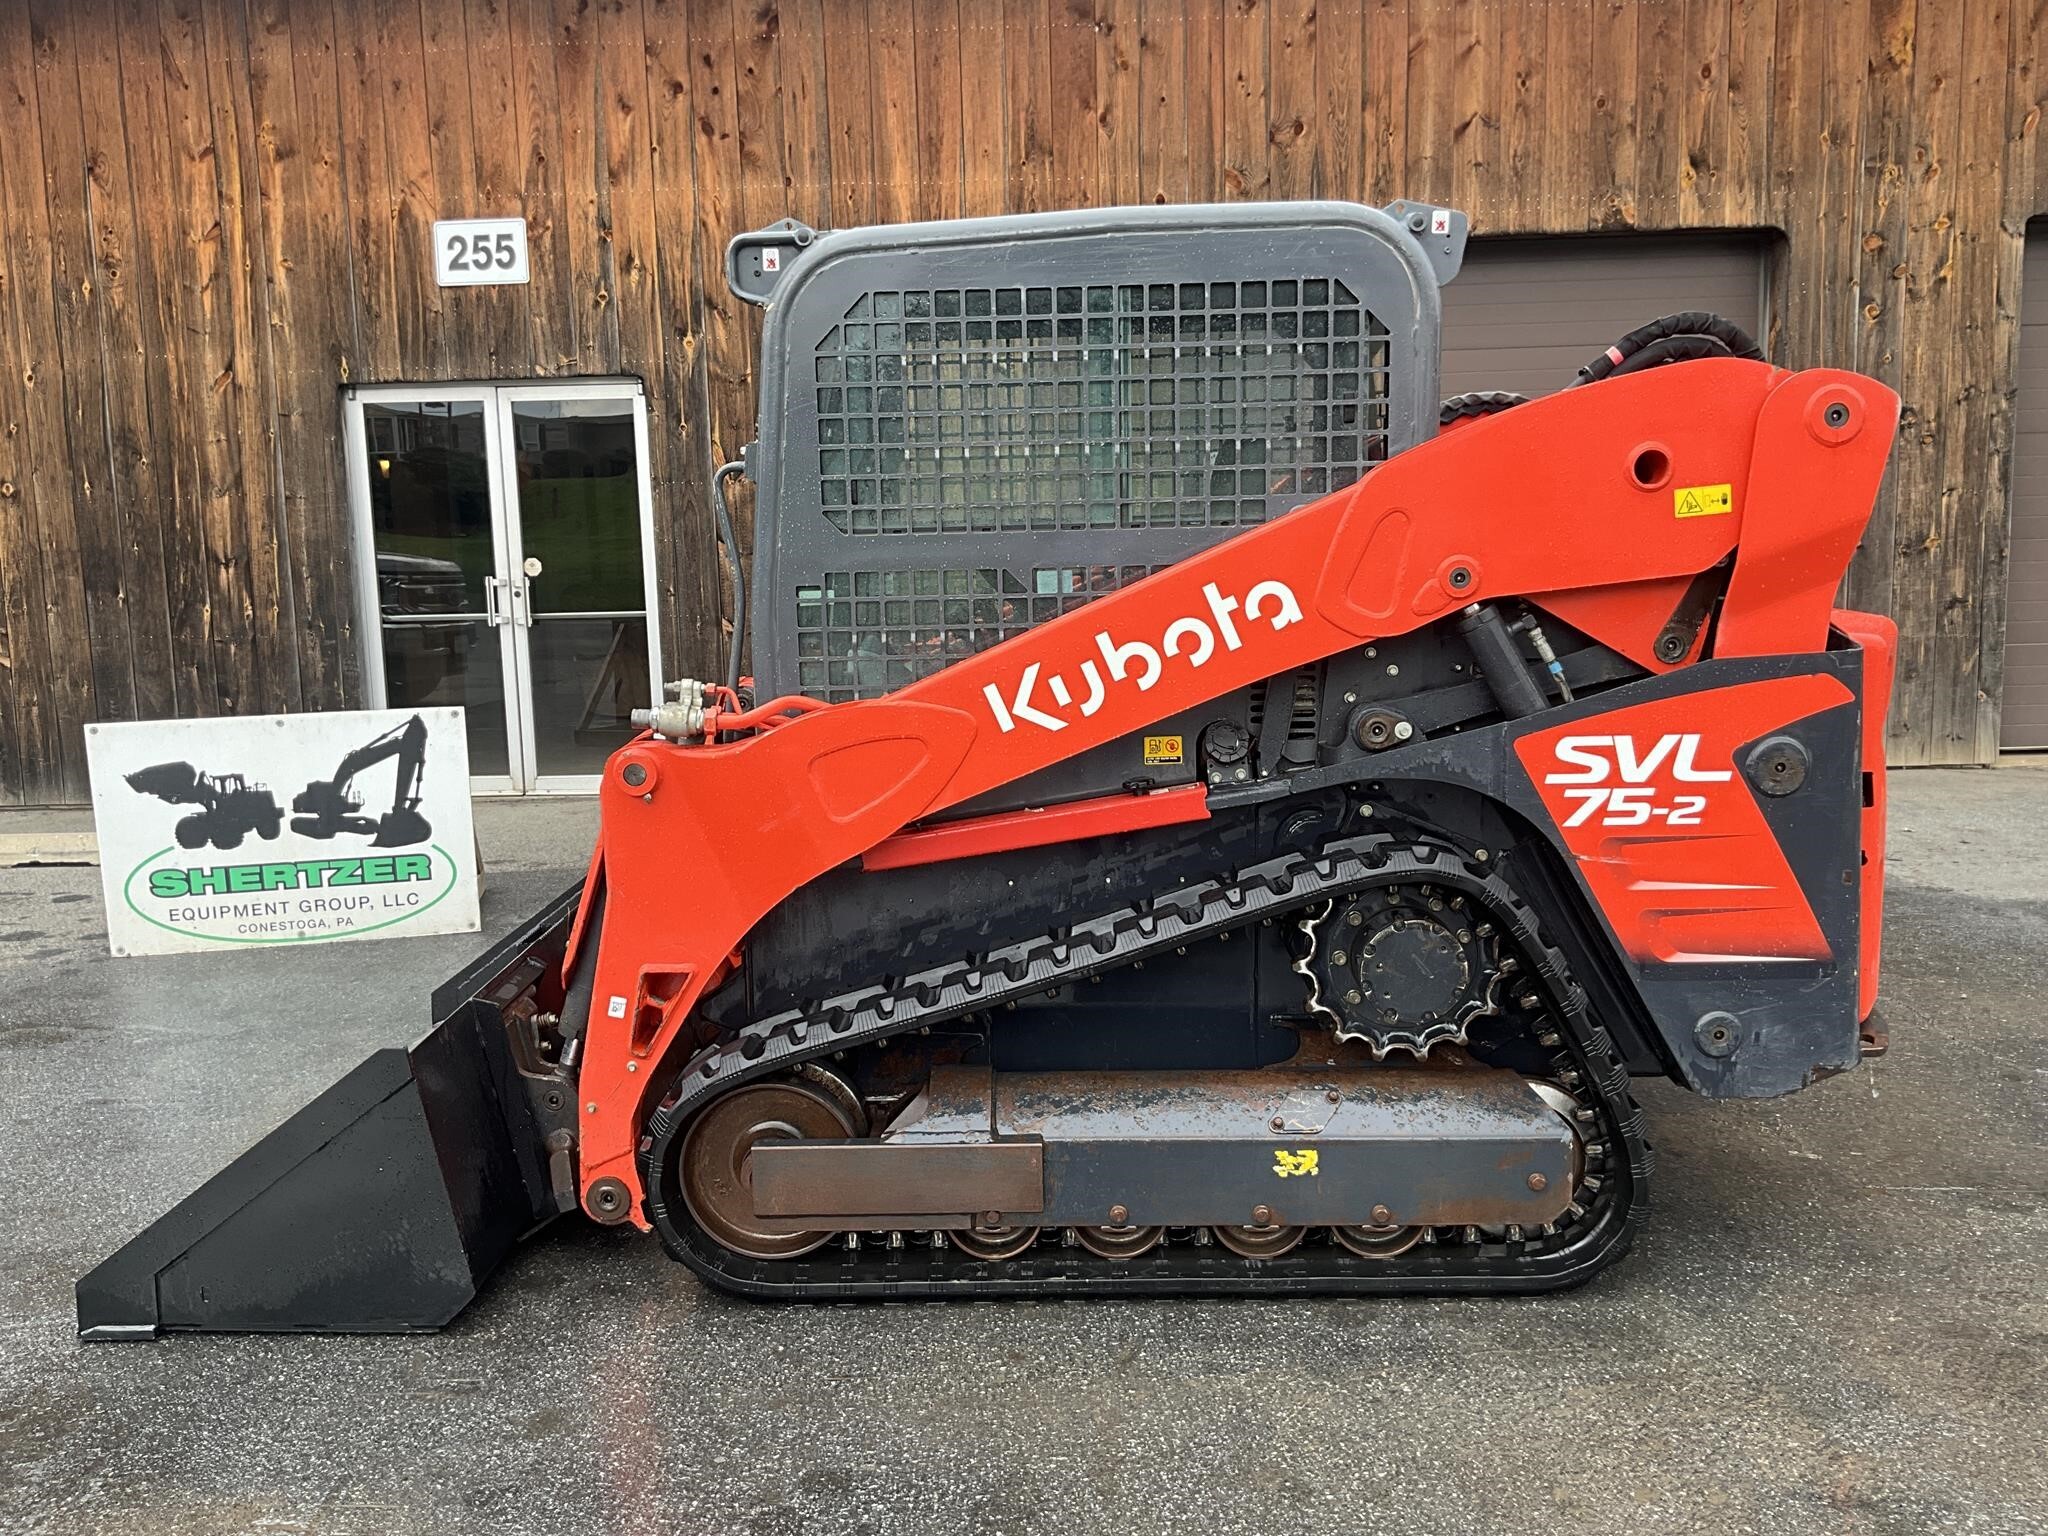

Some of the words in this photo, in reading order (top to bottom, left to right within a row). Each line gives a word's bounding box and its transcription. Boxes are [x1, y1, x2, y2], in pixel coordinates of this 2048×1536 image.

[447, 233, 517, 271] 255
[982, 580, 1304, 733] Kubota
[1544, 733, 1733, 784] SVL
[1562, 787, 1706, 827] 75-2
[149, 853, 432, 898] SHERTZER
[169, 901, 290, 922] EQUIPMENT
[299, 896, 375, 913] GROUP,
[383, 892, 420, 907] LLC
[238, 918, 331, 934] CONESTOGA,
[336, 917, 354, 927] PA
